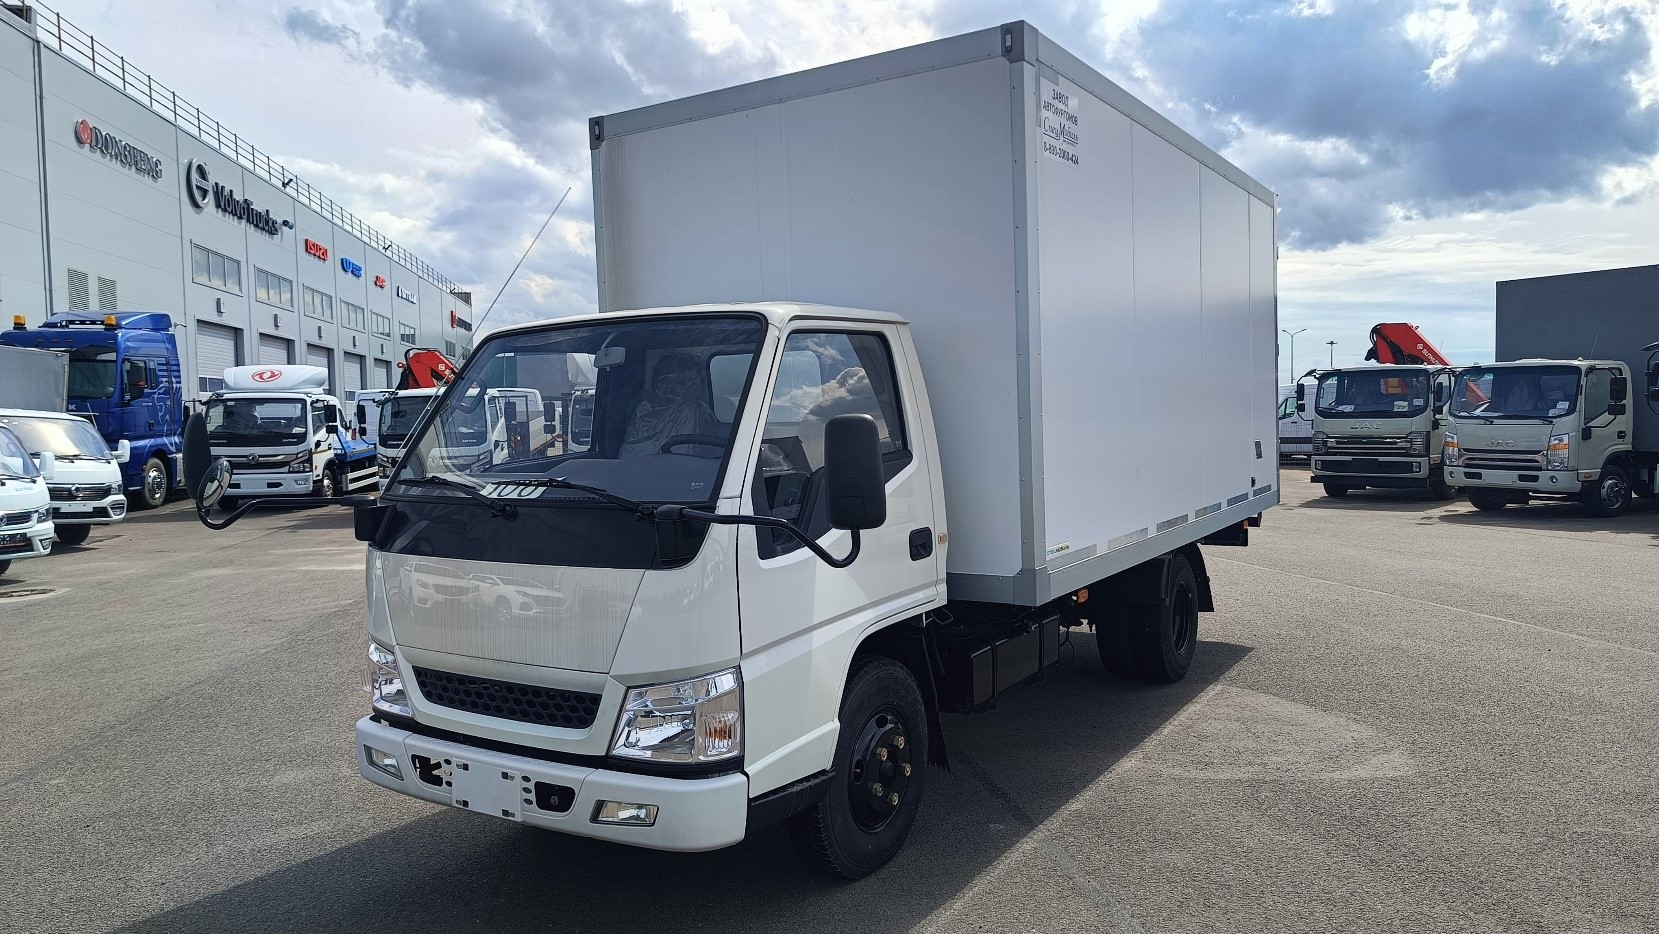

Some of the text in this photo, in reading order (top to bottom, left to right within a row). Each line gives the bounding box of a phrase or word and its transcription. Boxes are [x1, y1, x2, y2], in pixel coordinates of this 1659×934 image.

[1052, 89, 1069, 109] ЗАВОД
[1043, 100, 1078, 126] АВТОФУРГОНОВ
[89, 125, 163, 179] DONGFENG
[305, 239, 329, 262] ISUZU
[1350, 422, 1382, 430] JAC
[1486, 439, 1516, 448] JAC
